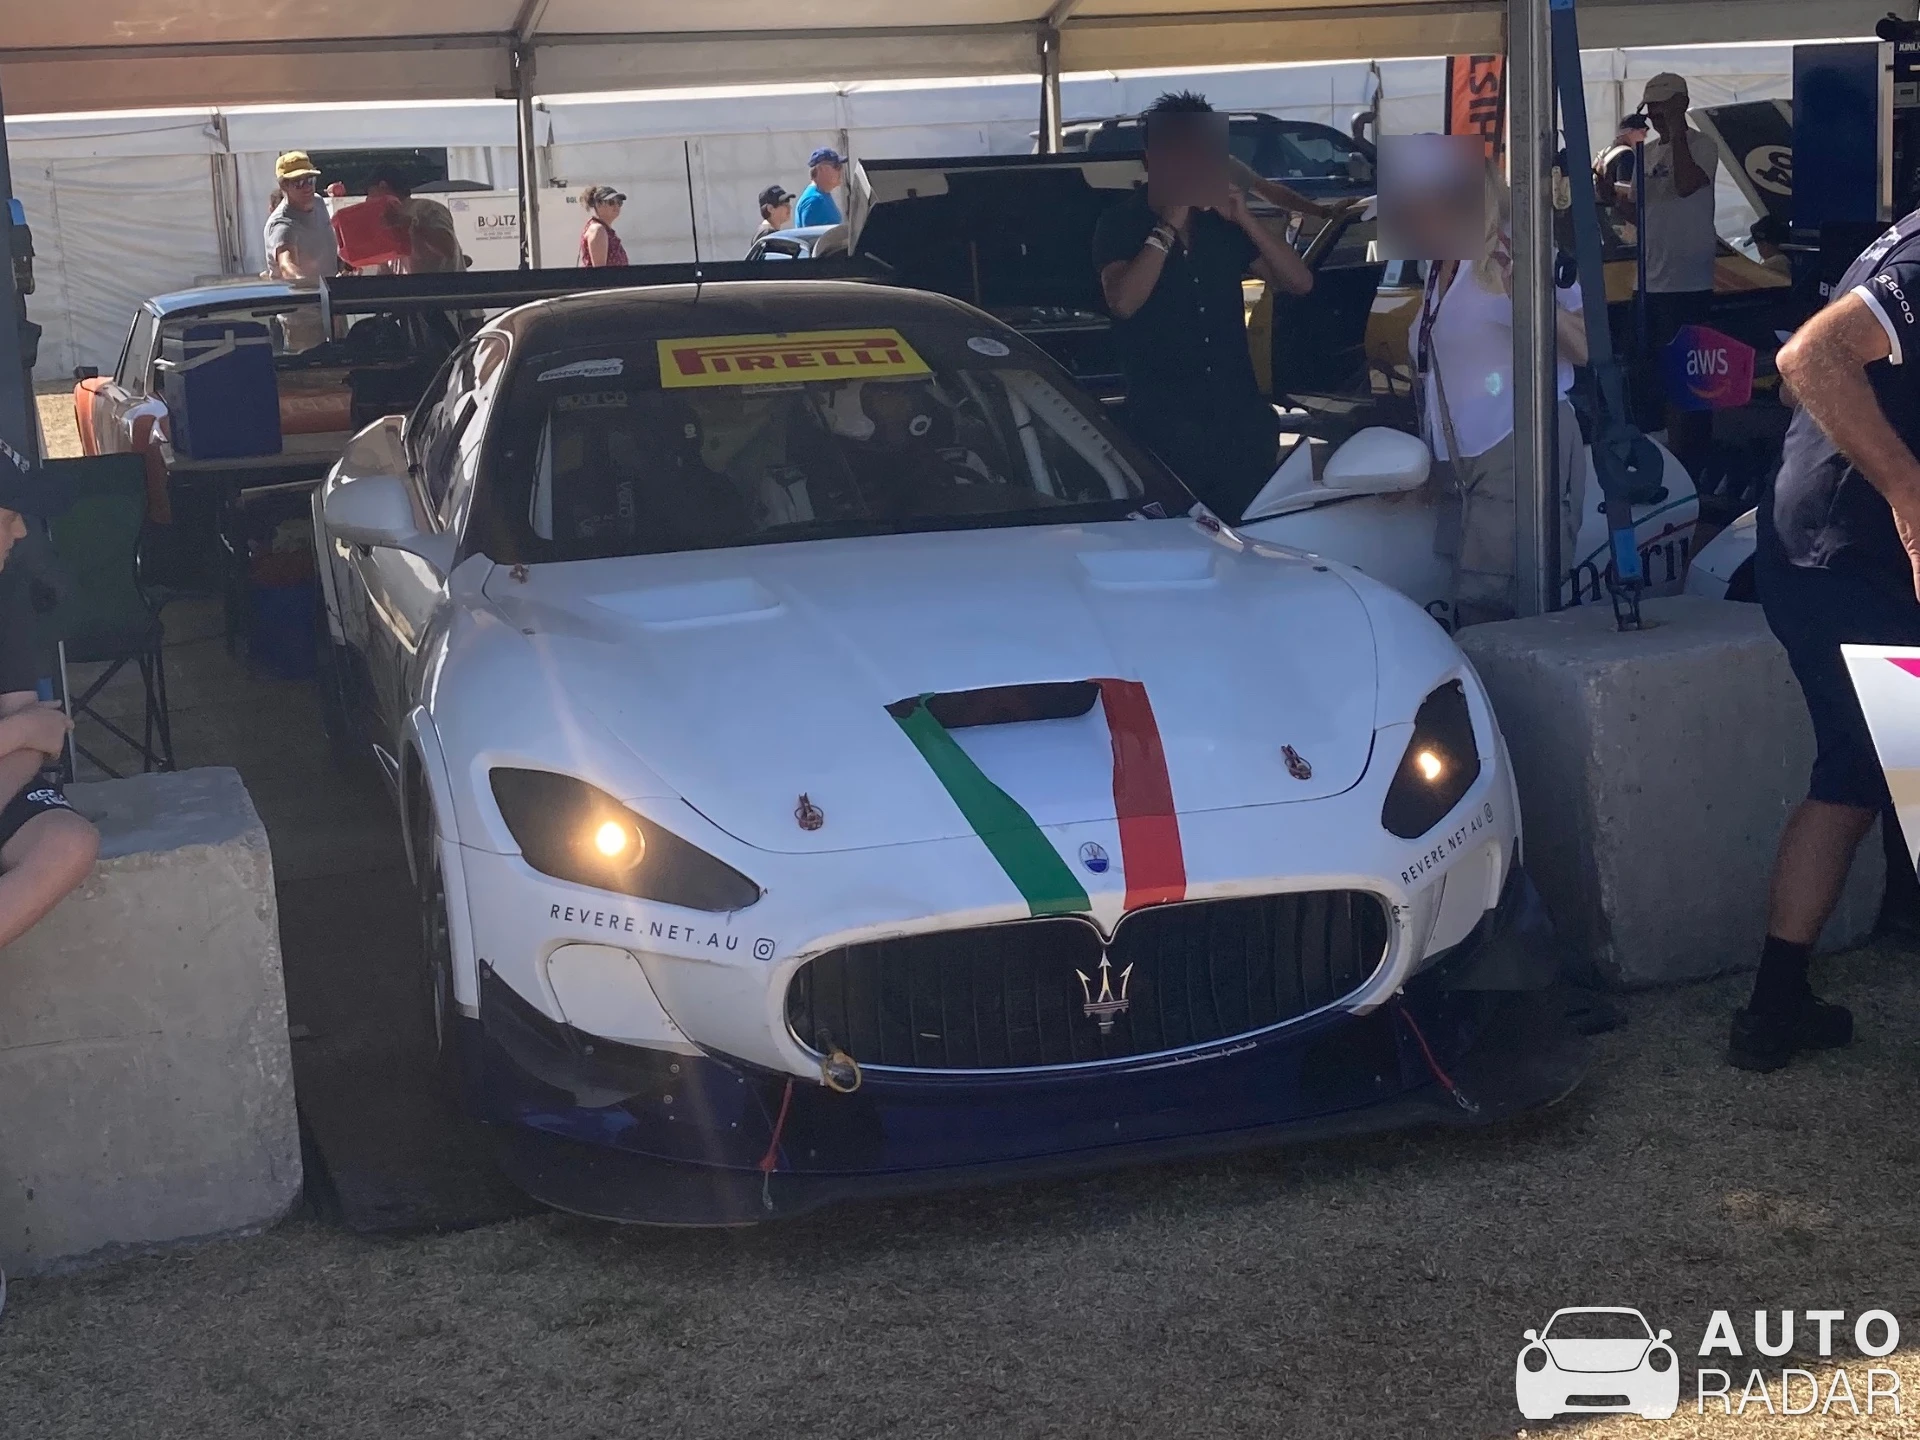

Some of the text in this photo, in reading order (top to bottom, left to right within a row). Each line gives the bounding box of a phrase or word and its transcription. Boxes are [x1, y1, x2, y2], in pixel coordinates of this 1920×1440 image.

[478, 214, 517, 228] BOLTZ
[672, 338, 906, 376] PIRELLI
[1686, 348, 1729, 376] aws
[550, 903, 738, 951] REVERE.NET.AU
